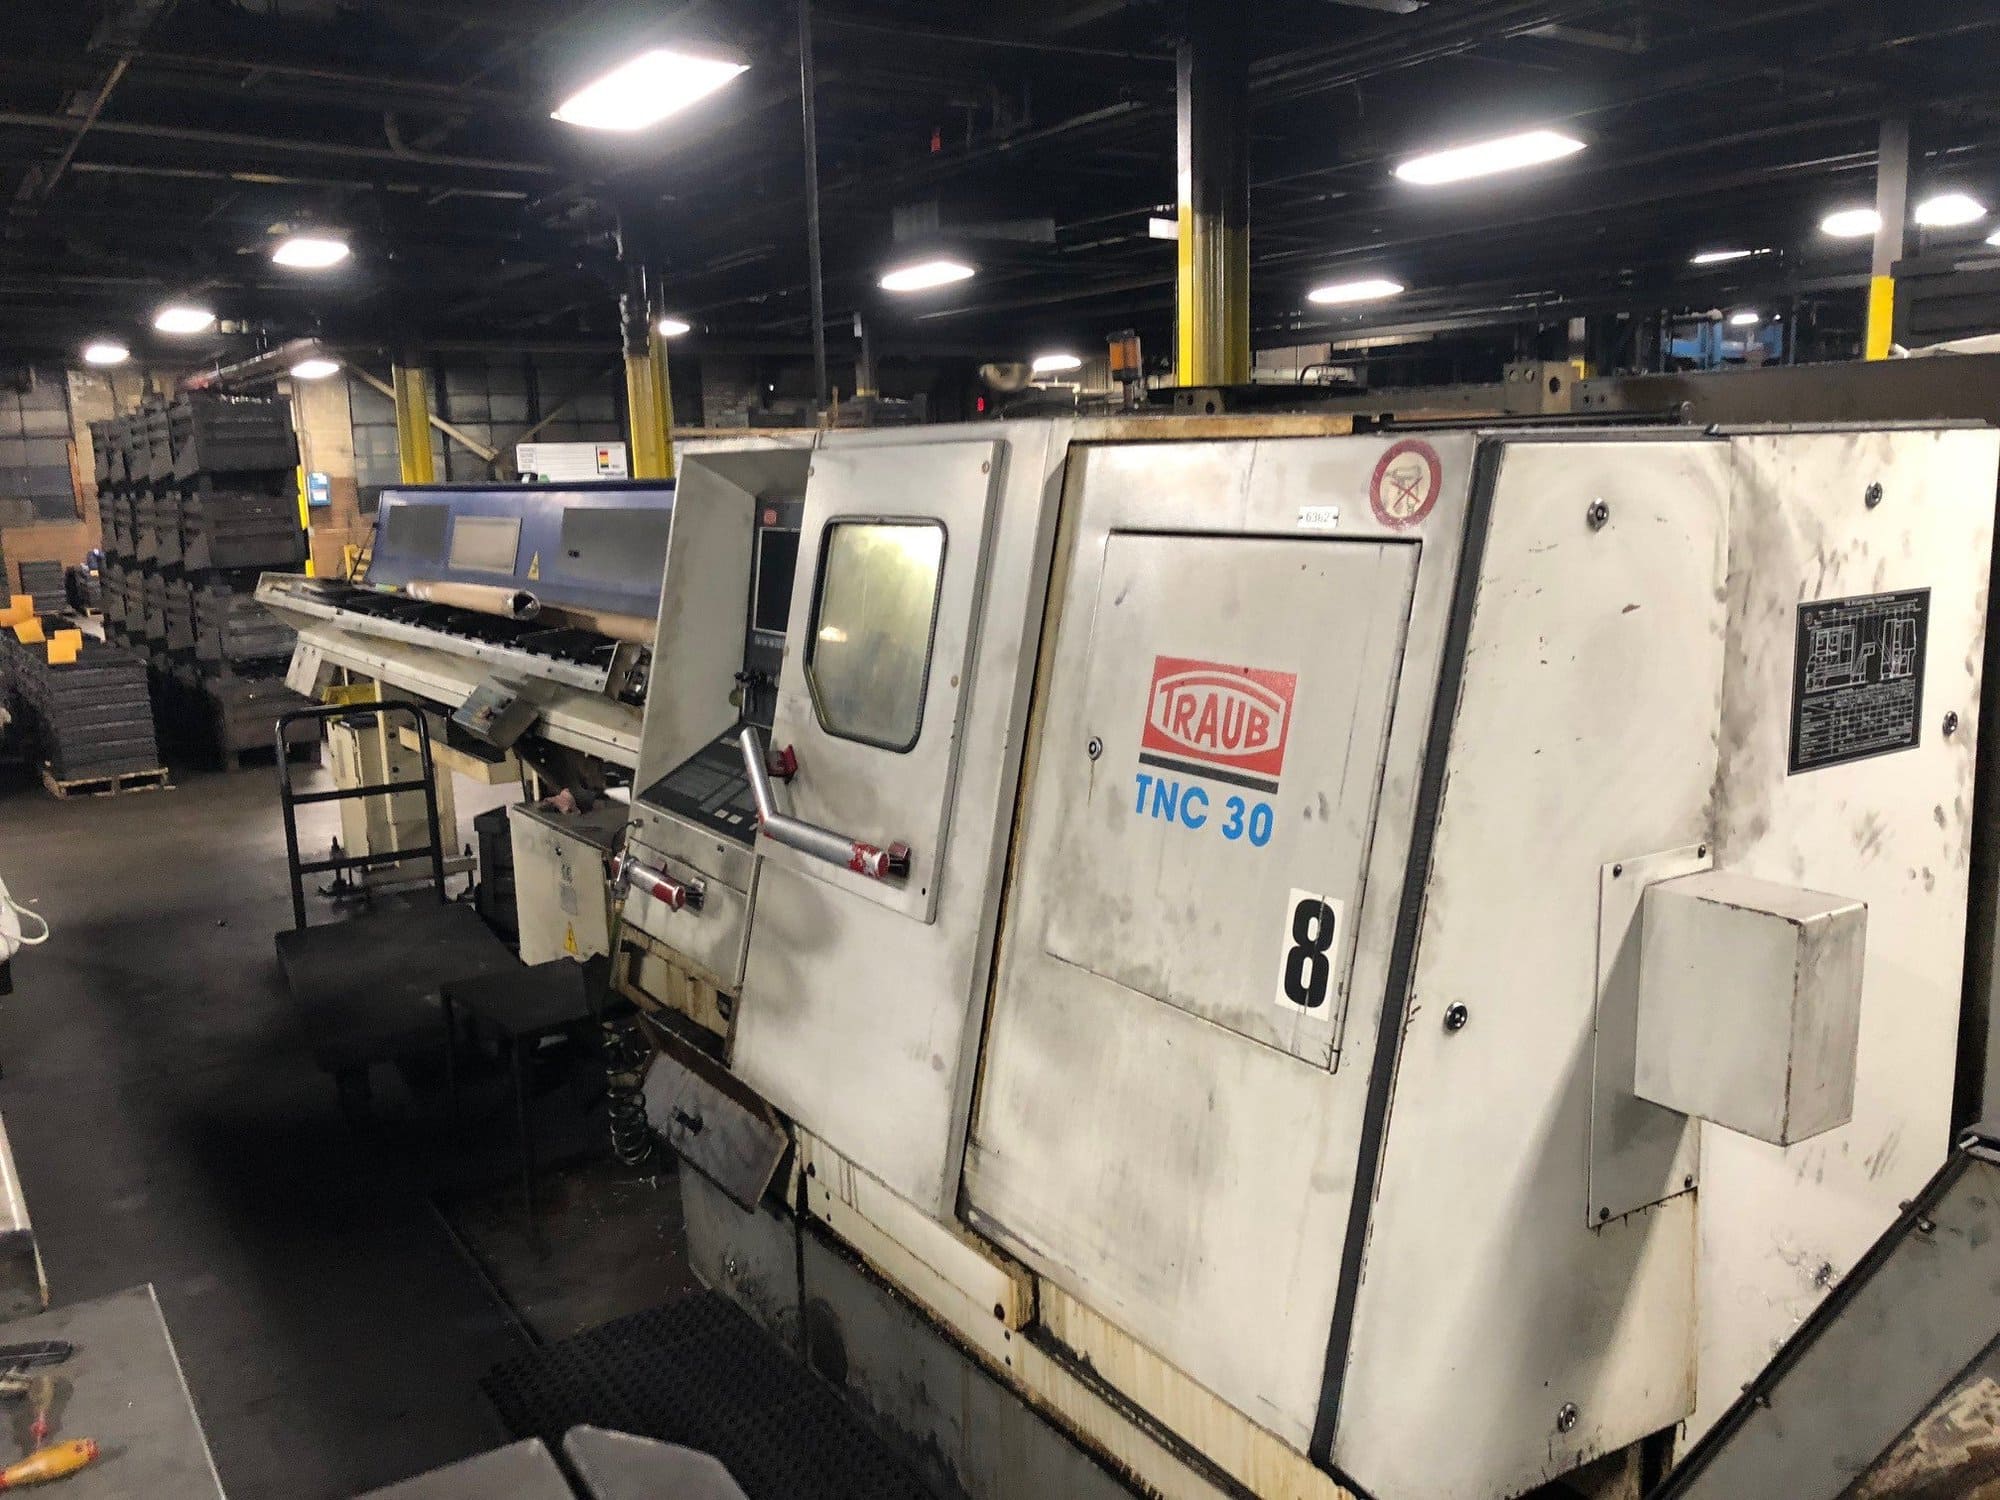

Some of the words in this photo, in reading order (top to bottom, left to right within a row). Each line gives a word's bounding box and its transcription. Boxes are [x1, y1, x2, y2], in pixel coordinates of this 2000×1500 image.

[1159, 676, 1281, 750] TRAUB
[1135, 773, 1210, 829] TNC
[1222, 796, 1274, 847] 30
[1284, 898, 1335, 1008] 8
